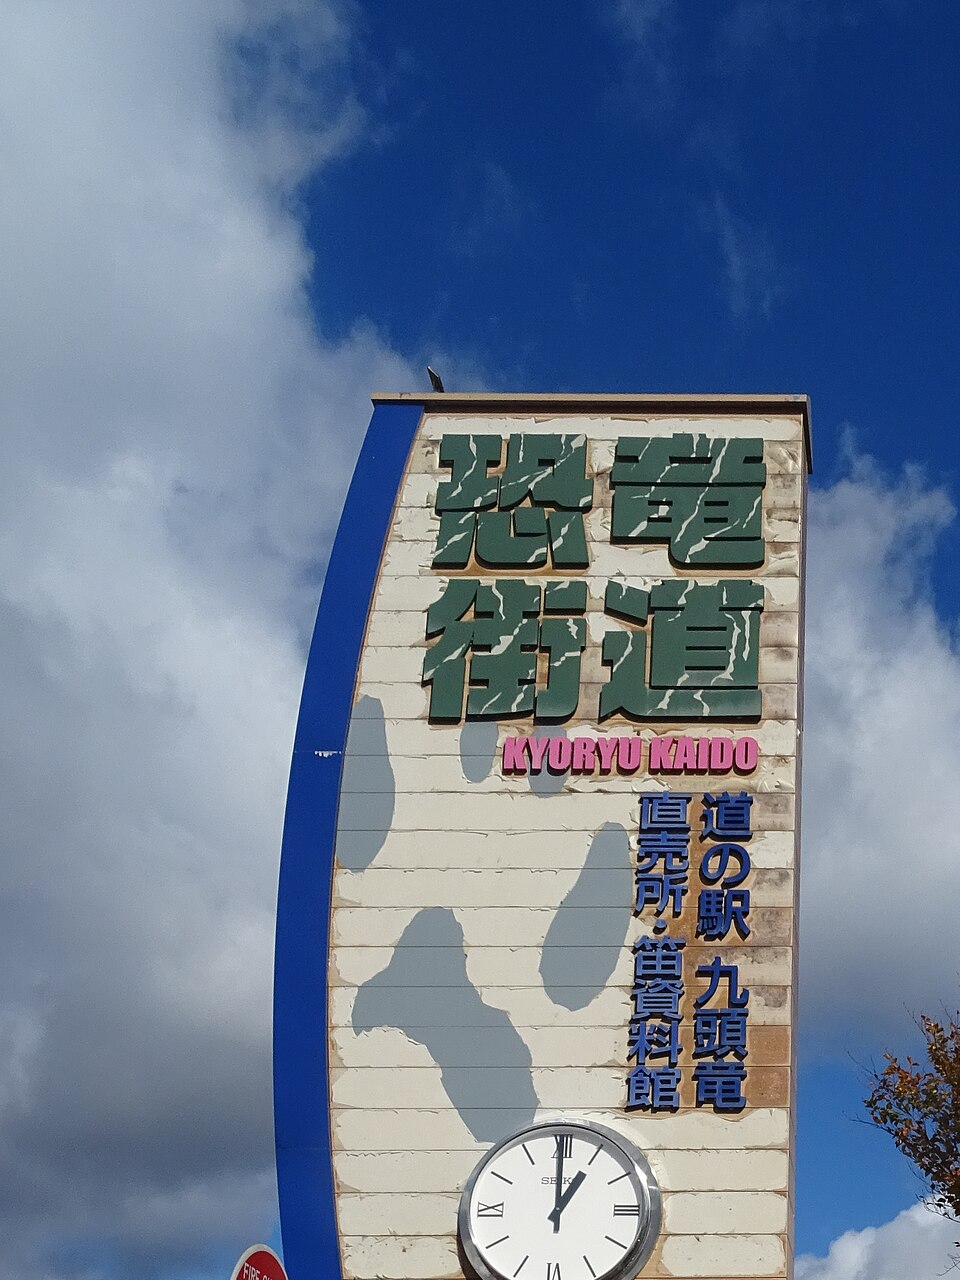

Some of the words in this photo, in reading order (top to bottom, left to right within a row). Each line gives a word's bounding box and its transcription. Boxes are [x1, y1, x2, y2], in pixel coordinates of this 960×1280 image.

[432, 433, 767, 568] 恐竜
[422, 579, 764, 724] 街道
[503, 736, 641, 771] KYORYU
[649, 736, 758, 771] KAIDO
[699, 791, 753, 940] 道の駅
[694, 956, 749, 1109] 九頭竜
